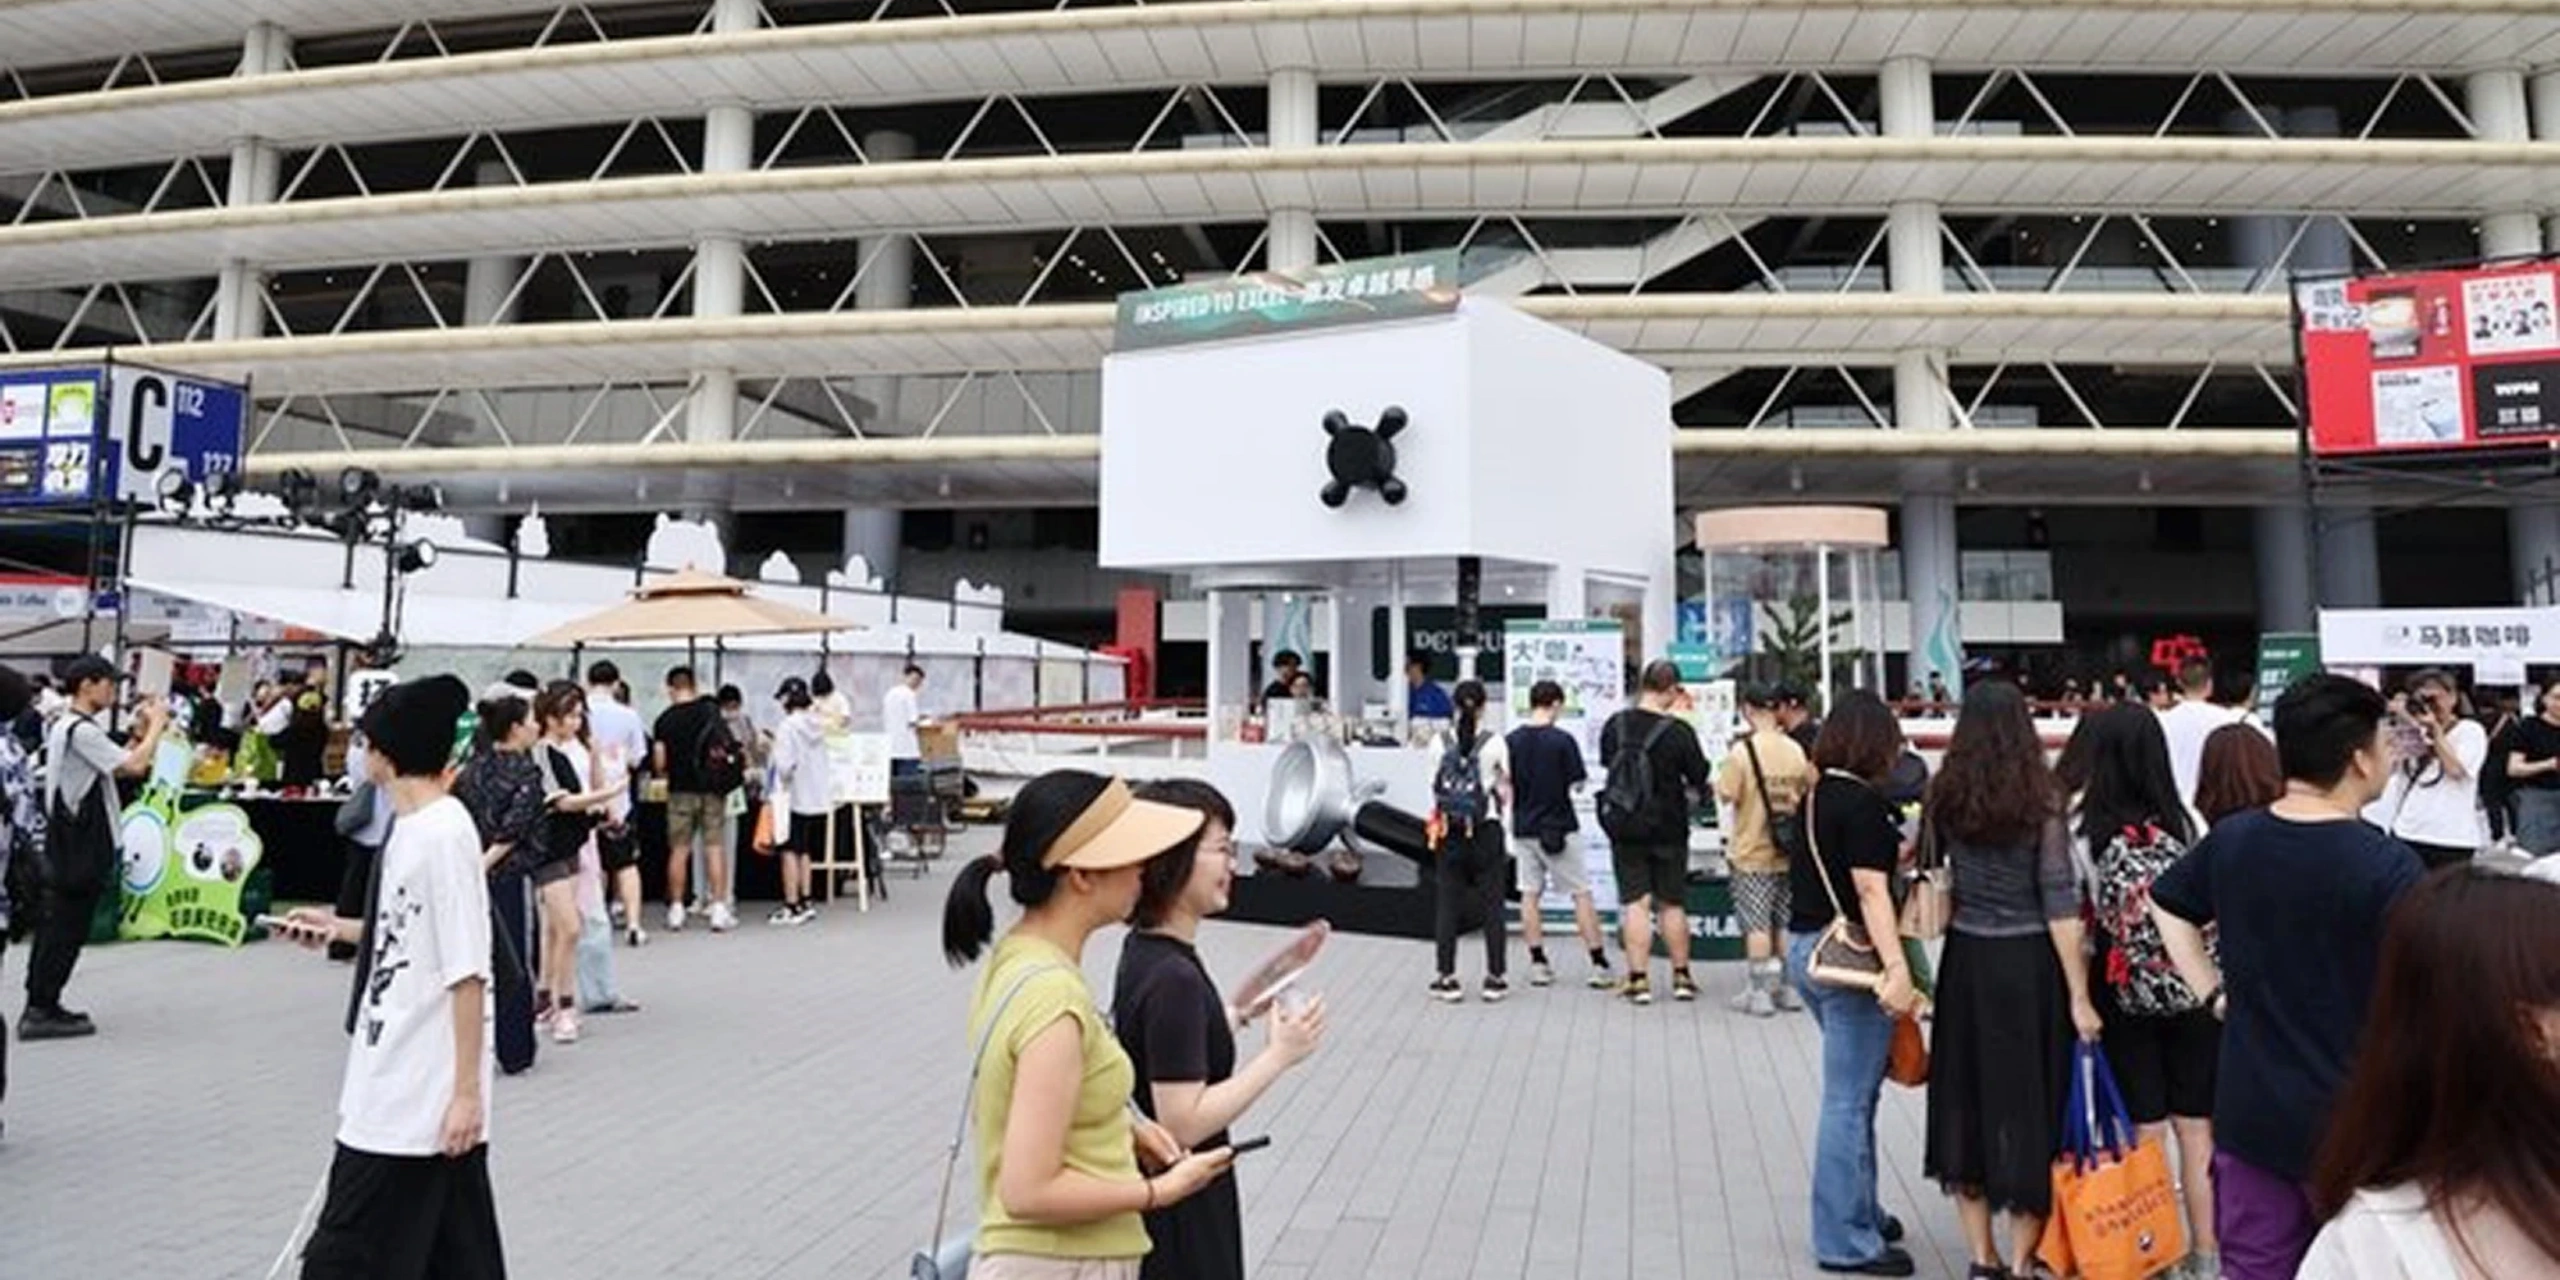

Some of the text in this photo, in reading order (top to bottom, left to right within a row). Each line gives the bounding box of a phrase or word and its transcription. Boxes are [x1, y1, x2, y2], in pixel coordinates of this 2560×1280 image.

[1213, 290, 1235, 315] TO
[178, 384, 205, 417] 112
[129, 376, 167, 473] C
[2418, 624, 2531, 648] 马路咖啡
